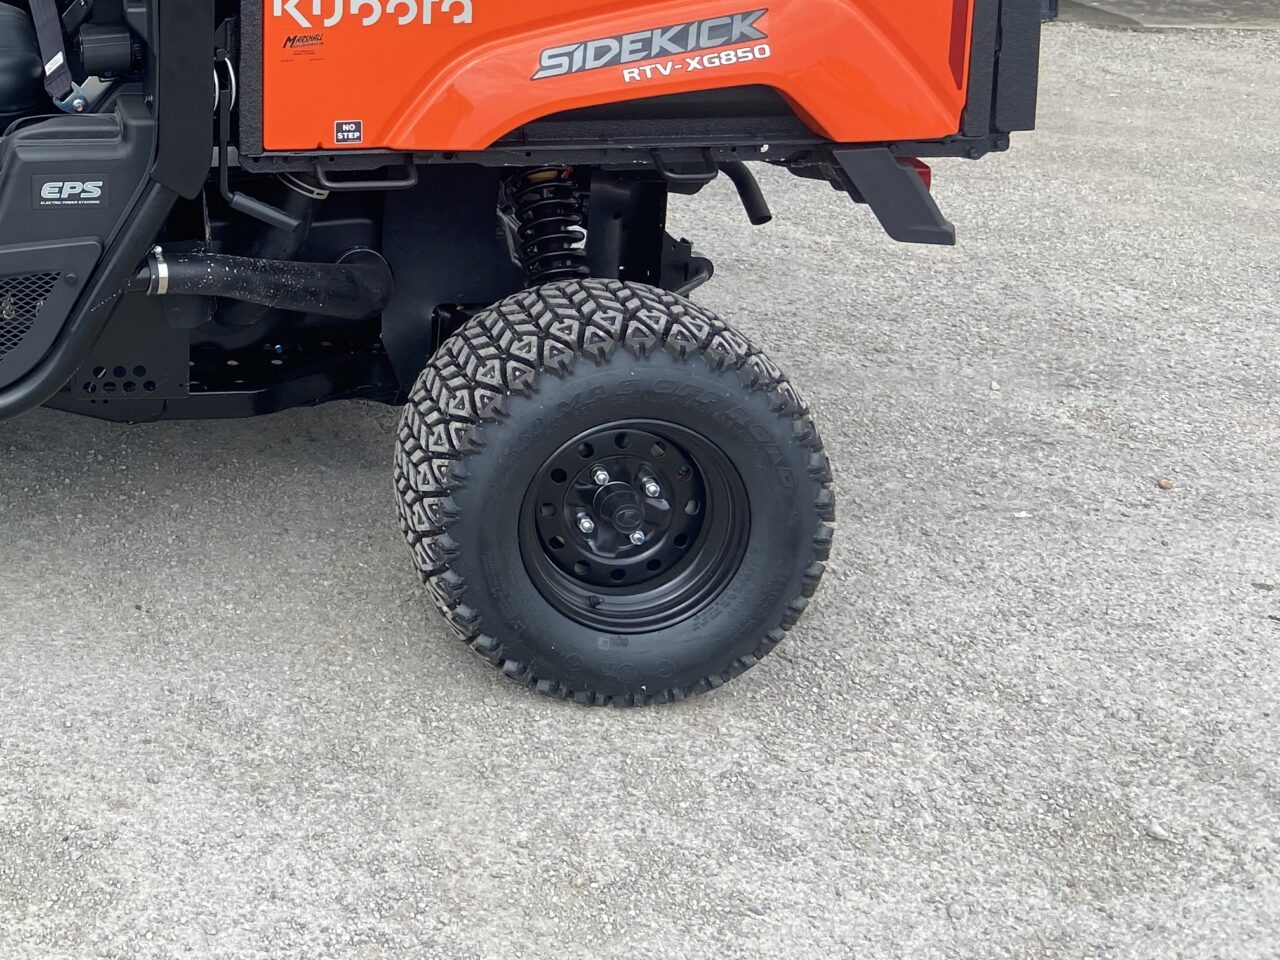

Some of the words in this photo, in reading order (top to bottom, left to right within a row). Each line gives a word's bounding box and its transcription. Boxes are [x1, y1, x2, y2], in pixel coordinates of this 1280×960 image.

[531, 8, 769, 80] SIDEKICK
[622, 43, 771, 82] RTV-XG850
[342, 123, 356, 131] NO
[40, 181, 103, 198] EPS
